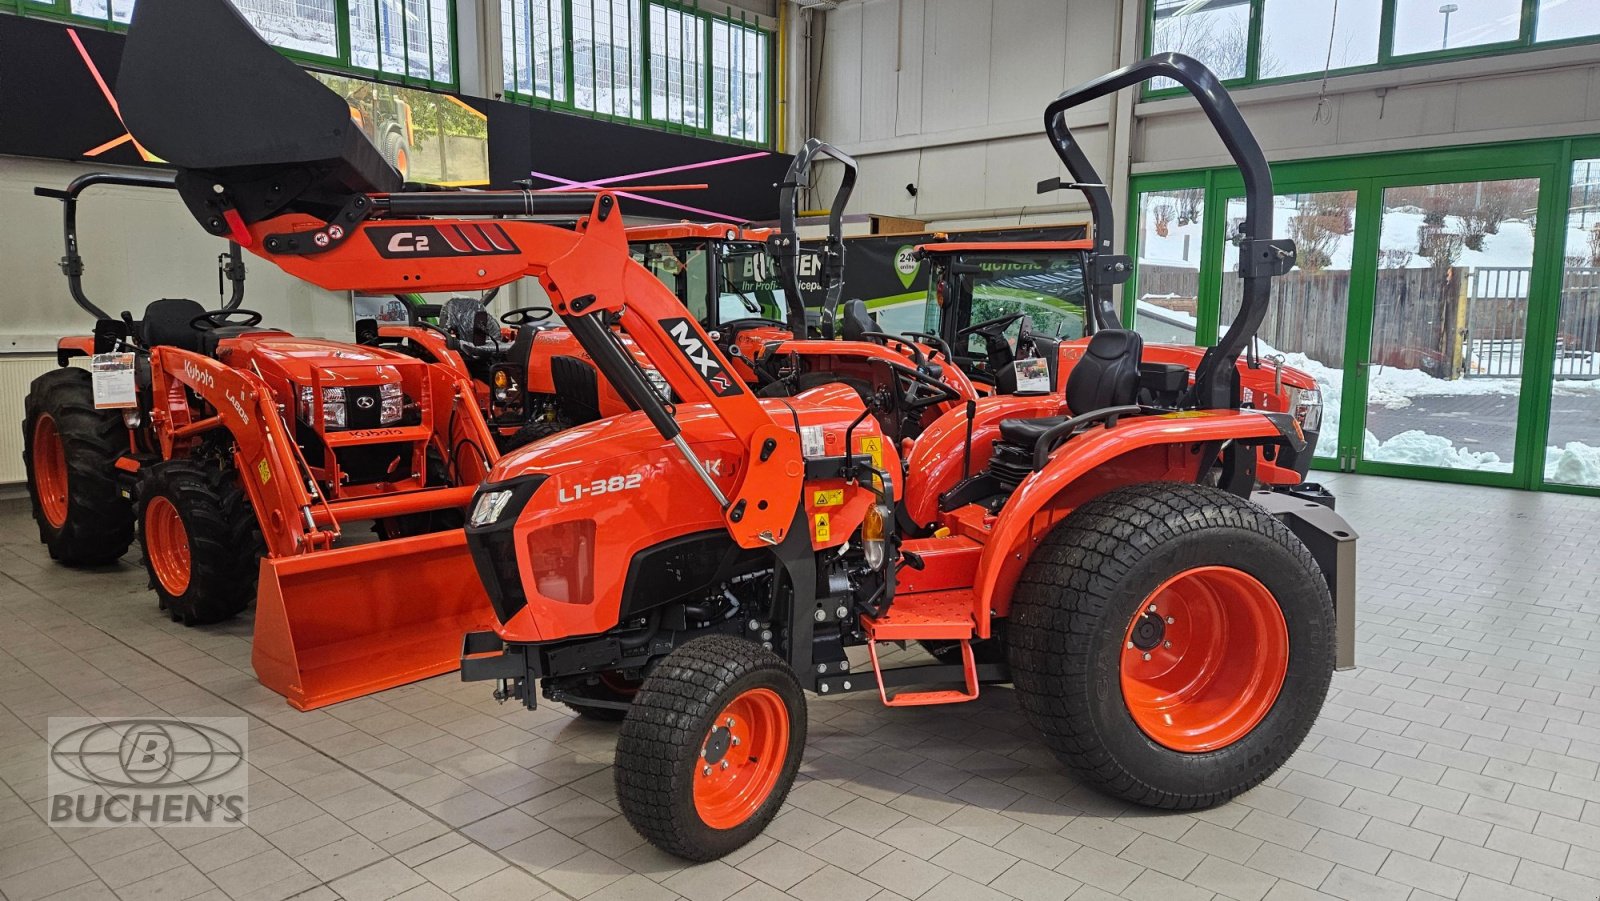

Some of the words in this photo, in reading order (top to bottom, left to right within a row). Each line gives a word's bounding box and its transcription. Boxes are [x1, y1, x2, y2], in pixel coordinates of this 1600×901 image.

[387, 232, 430, 252] C2
[742, 282, 753, 291] Ihr
[669, 320, 720, 378] MX
[184, 359, 214, 389] Kubota
[348, 428, 404, 438] Kubota
[559, 473, 642, 503] L1-382
